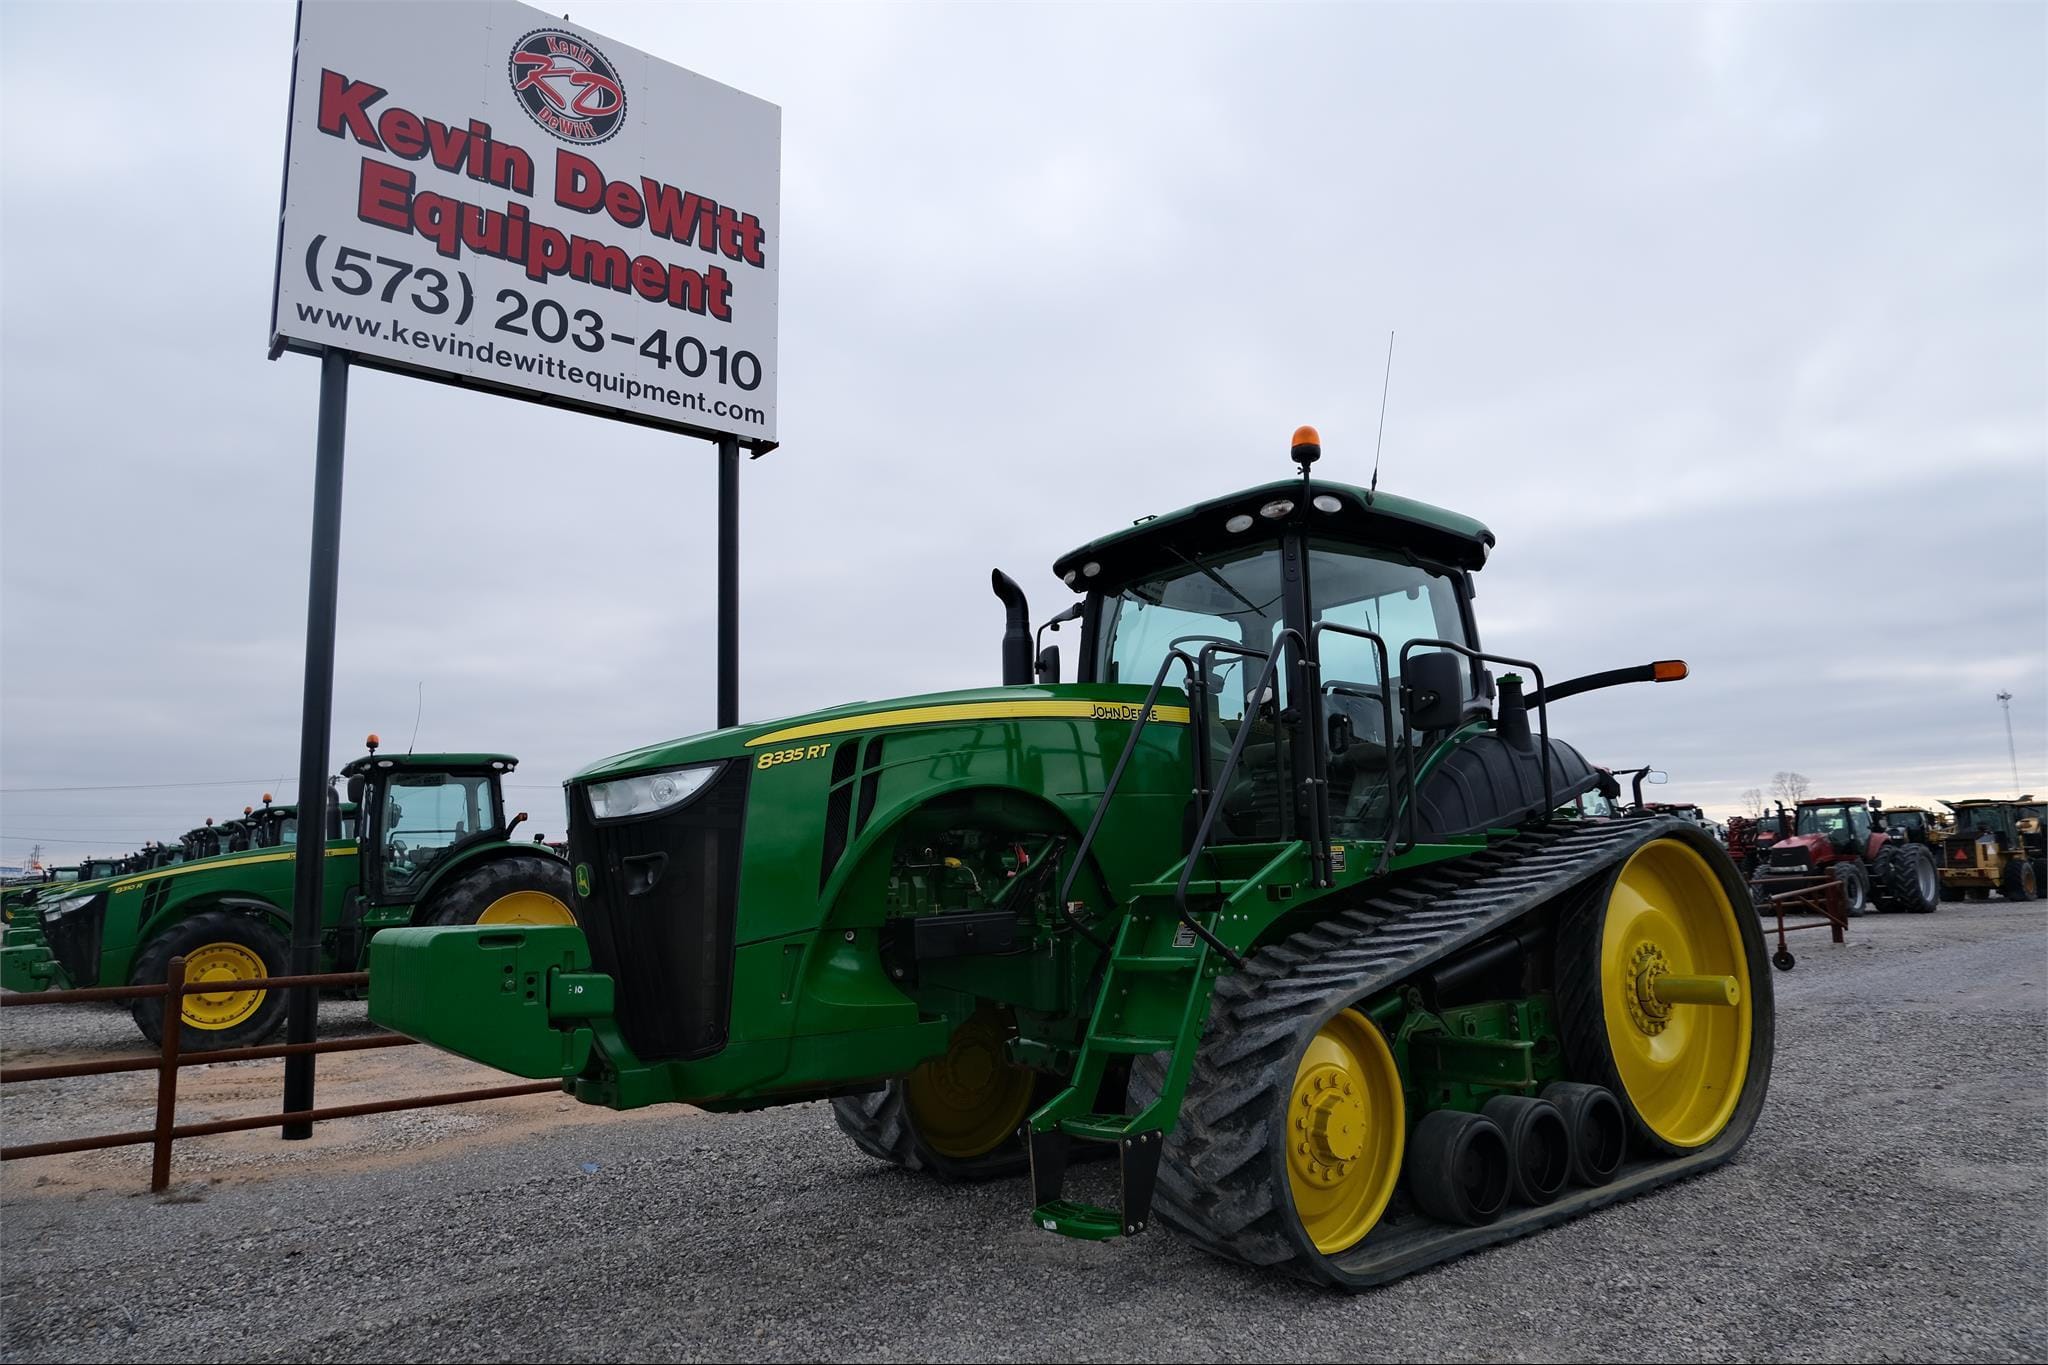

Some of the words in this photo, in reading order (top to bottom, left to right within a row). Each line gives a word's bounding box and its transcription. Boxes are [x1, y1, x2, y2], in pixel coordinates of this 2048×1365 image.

[546, 36, 594, 66] Kevin
[318, 68, 534, 197] Kevin
[554, 148, 765, 268] DeWitt
[538, 106, 597, 138] DeWitt
[358, 157, 732, 322] Equipment
[296, 302, 766, 425] www.kevindewittequipment.com
[305, 234, 474, 325] (573)
[495, 289, 762, 391] 203-4010
[757, 747, 805, 769] 8335
[806, 743, 831, 759] RT
